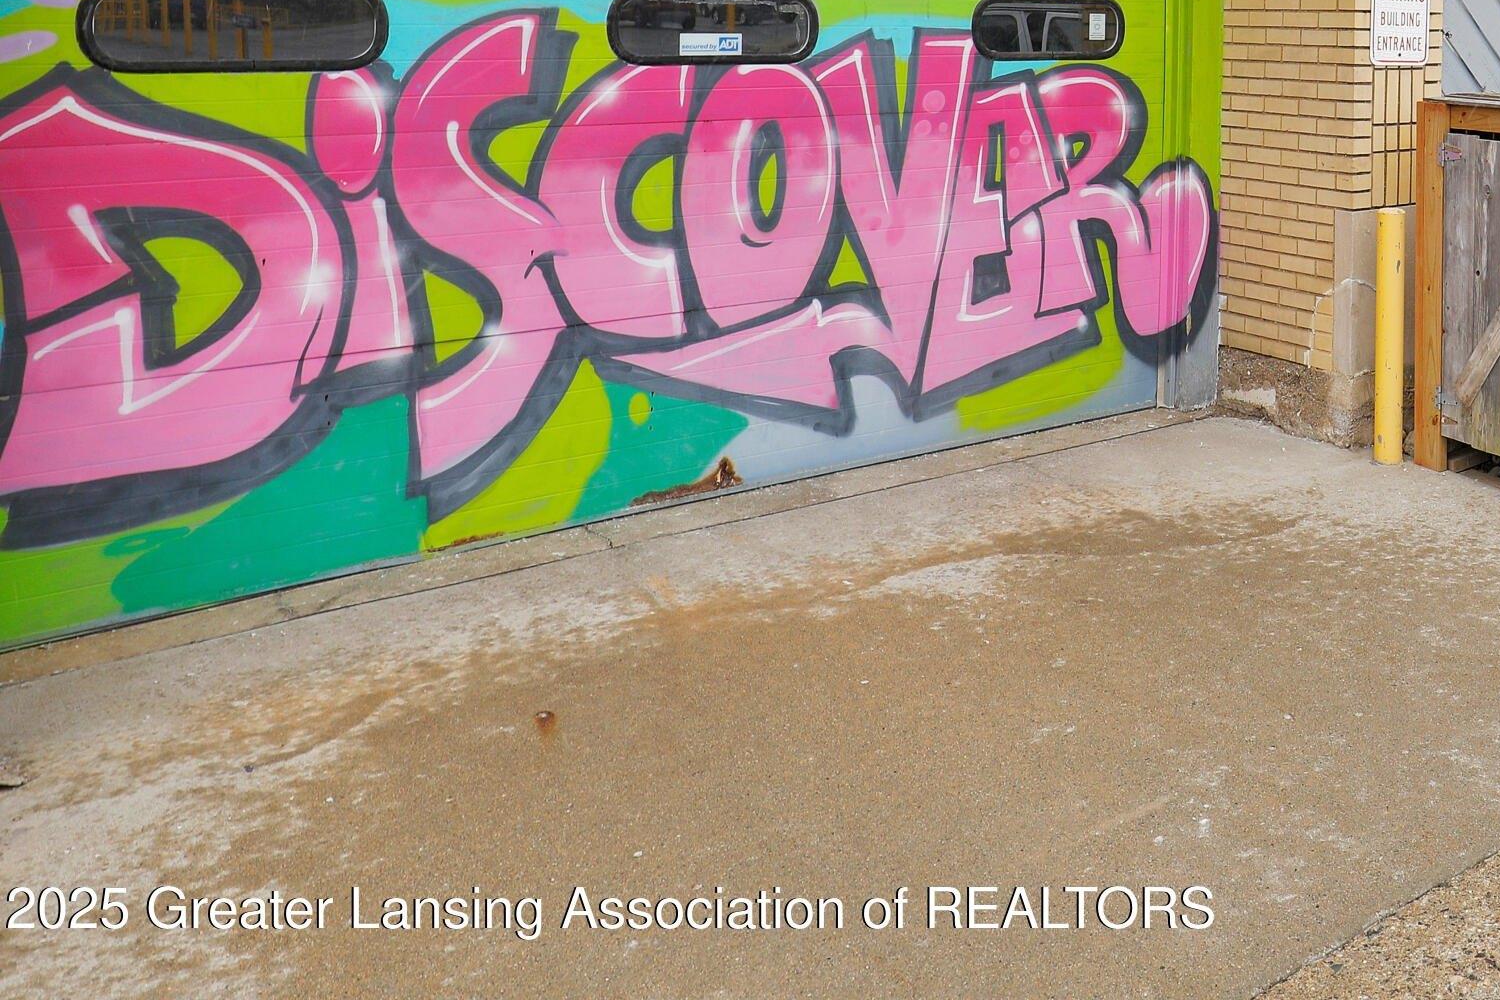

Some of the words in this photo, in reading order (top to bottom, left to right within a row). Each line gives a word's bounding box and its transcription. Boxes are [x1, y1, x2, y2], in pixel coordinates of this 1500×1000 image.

[1380, 11, 1421, 27] BUILDING
[719, 38, 738, 50] ADT
[1377, 35, 1422, 51] ENTRANCE
